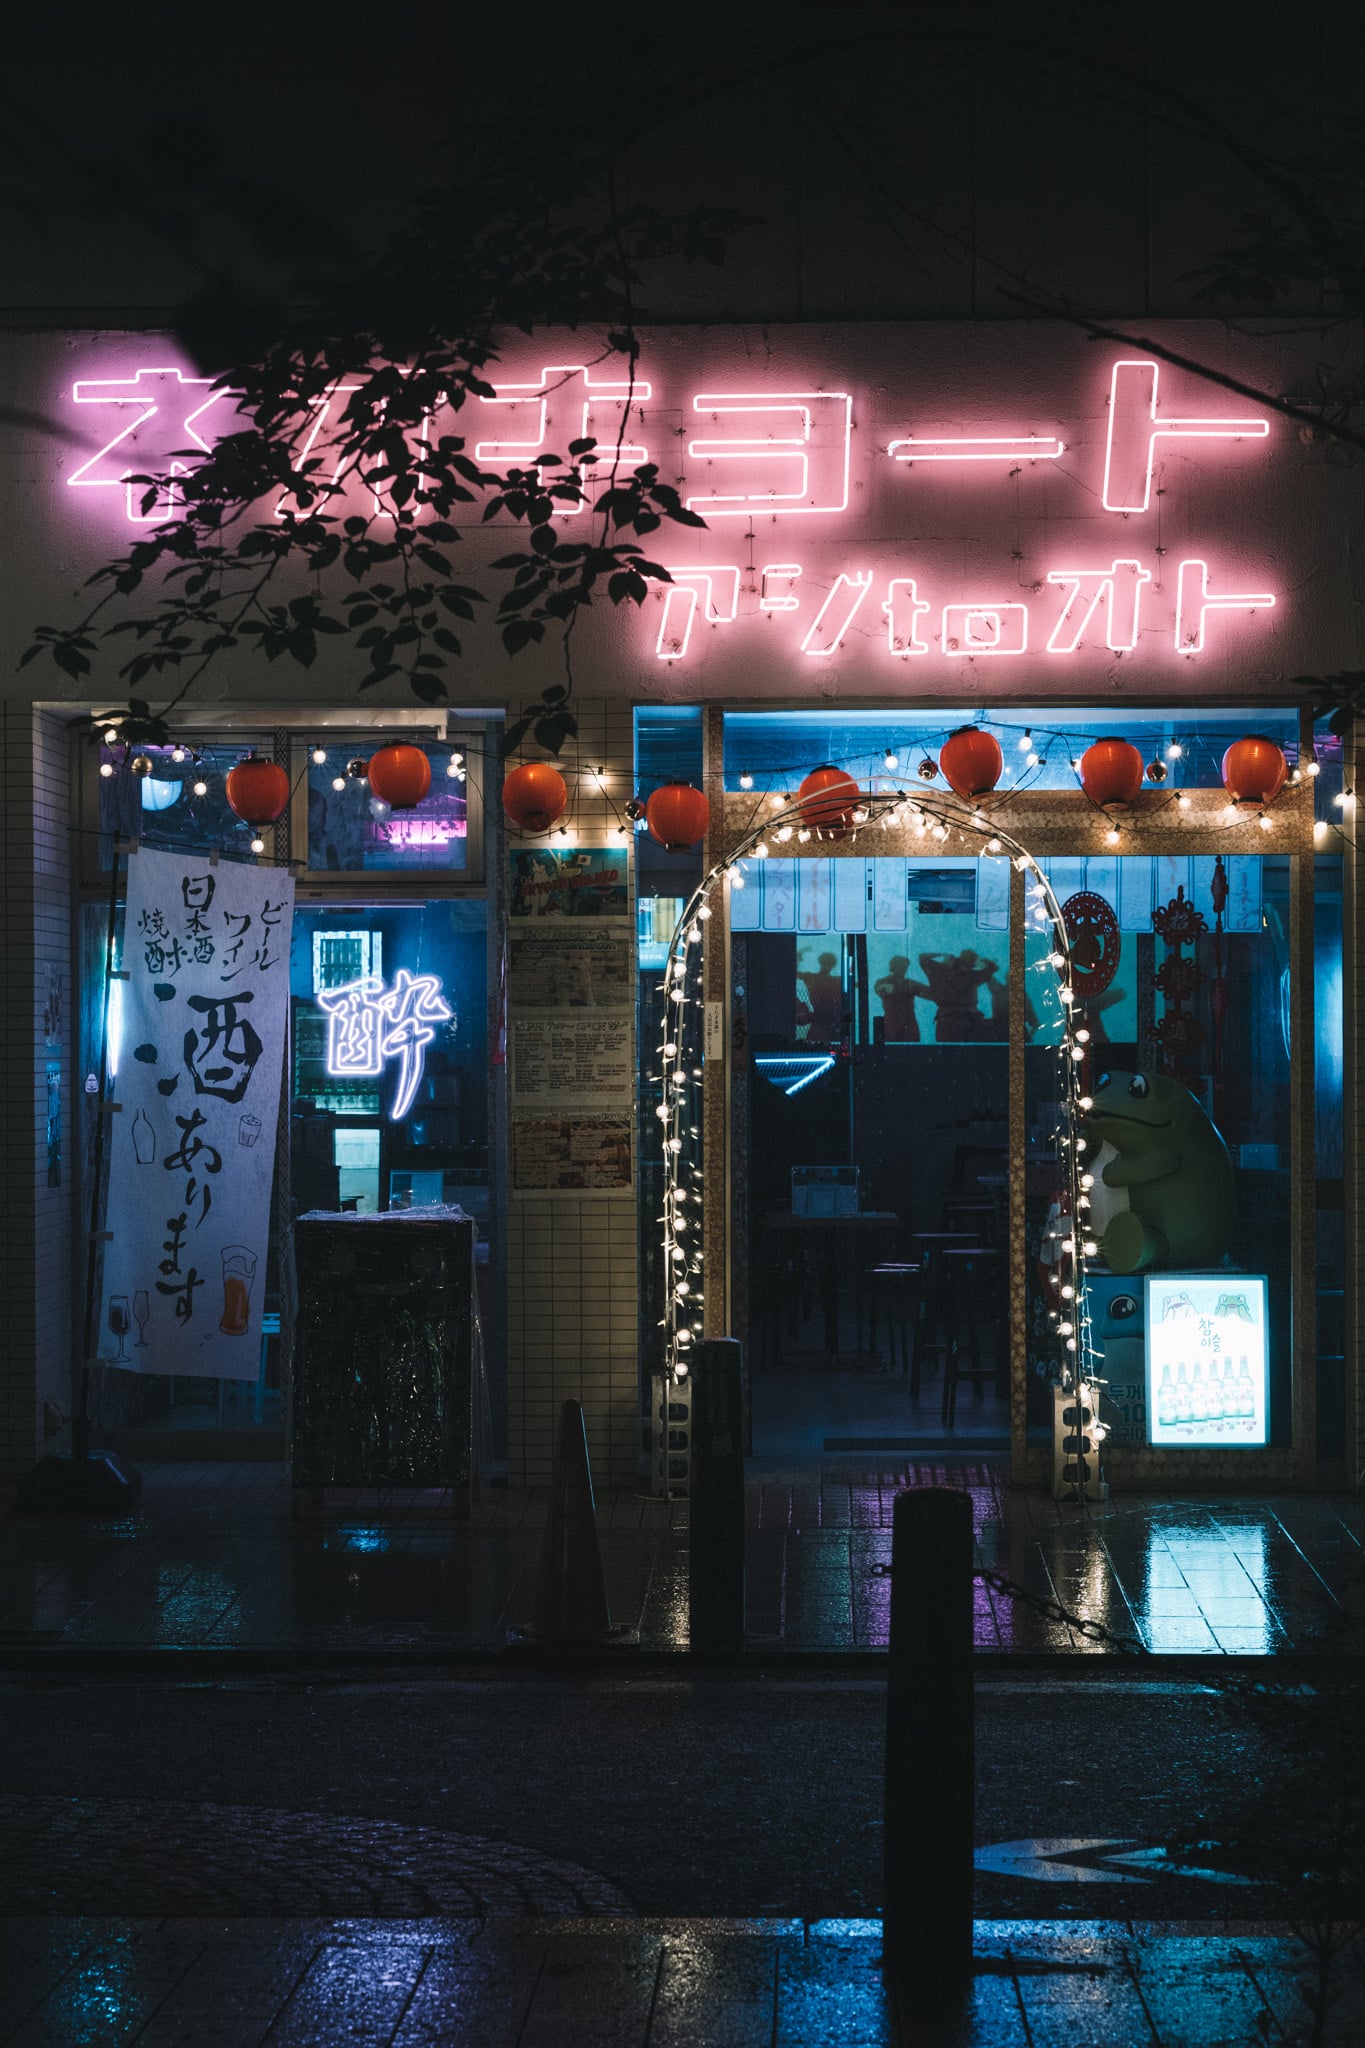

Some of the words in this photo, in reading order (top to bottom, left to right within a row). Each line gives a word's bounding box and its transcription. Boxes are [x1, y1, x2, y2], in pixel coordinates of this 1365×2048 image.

[138, 908, 184, 978] 焼酎
[181, 874, 216, 965] 日本酒
[223, 910, 251, 981] ワイン
[255, 900, 288, 971] ビール
[1108, 1385, 1145, 1400] 두꺼
